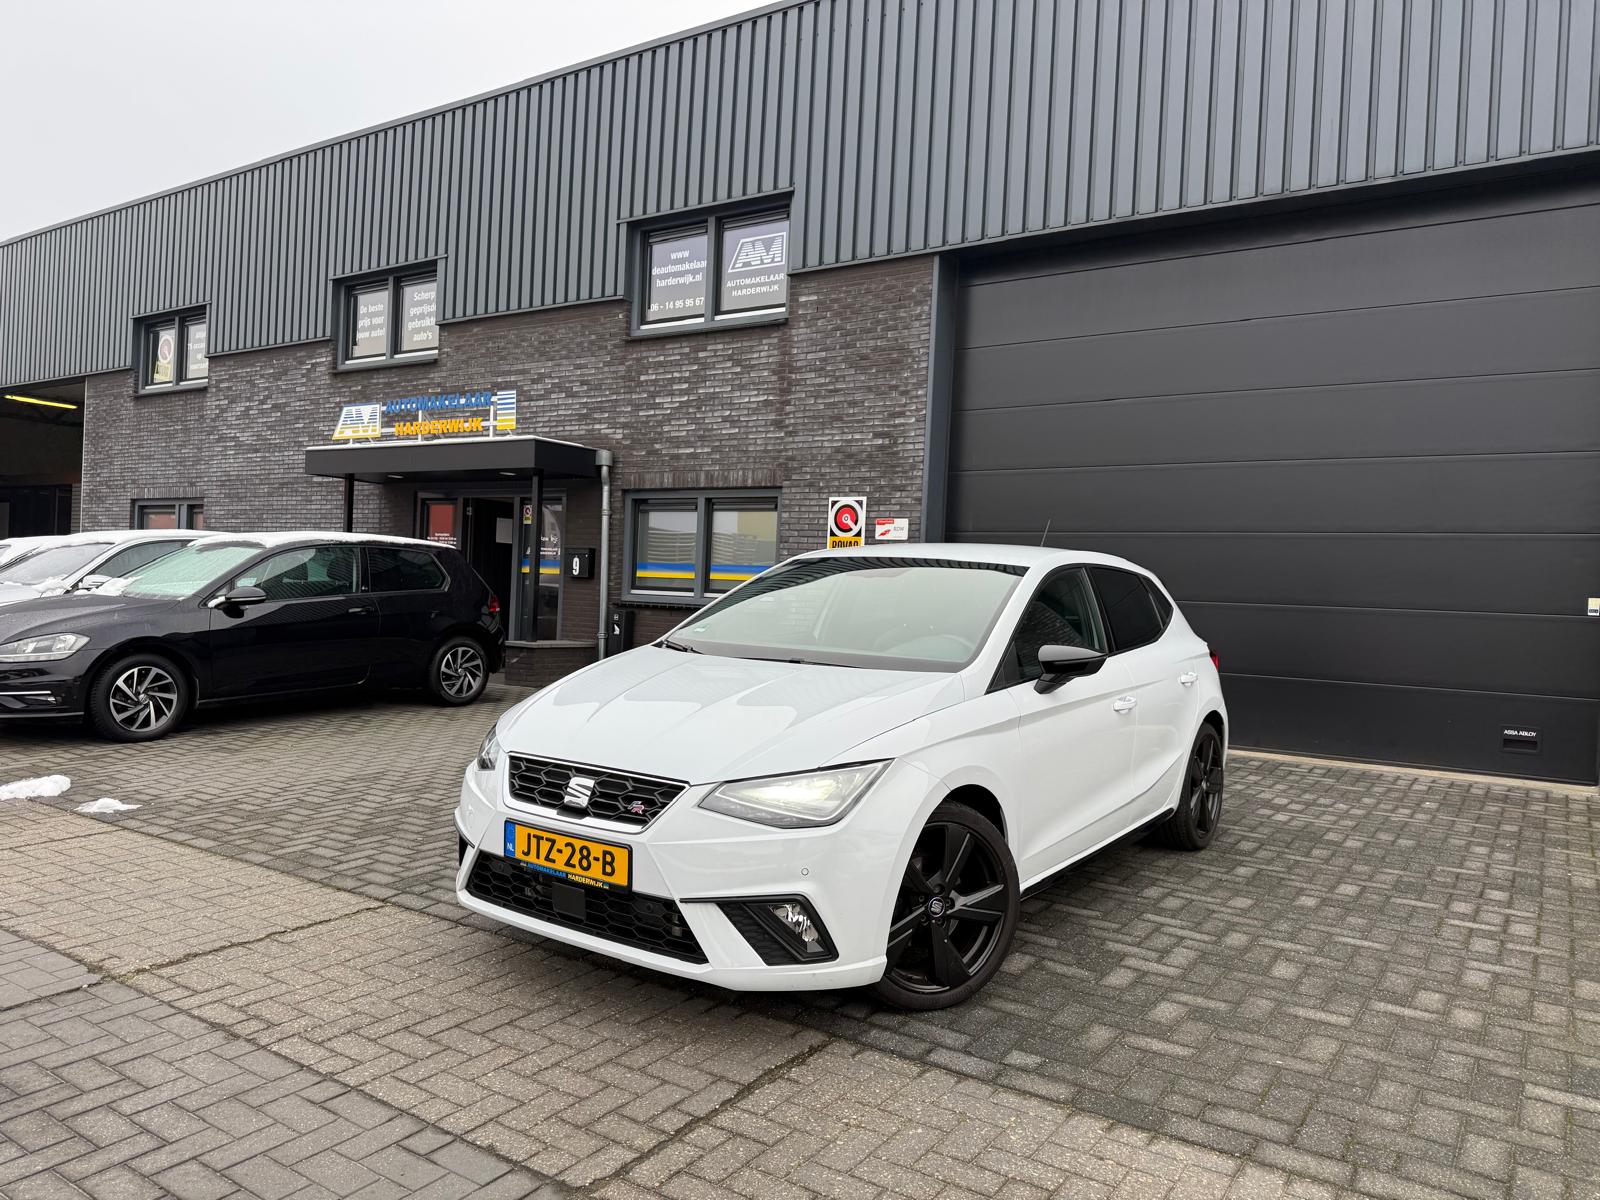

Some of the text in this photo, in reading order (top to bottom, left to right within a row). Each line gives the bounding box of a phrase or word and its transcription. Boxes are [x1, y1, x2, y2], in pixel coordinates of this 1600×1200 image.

[656, 271, 703, 288] harderwijk.nl
[727, 273, 785, 287] AUTOMAKELAAR
[731, 284, 780, 297] HARDERWIJK
[665, 300, 674, 311] 14
[674, 299, 684, 309] 95
[685, 298, 694, 308] 95
[385, 392, 493, 414] AUTOMAKELAAR
[395, 418, 484, 436] HARDERWIJK
[572, 556, 580, 576] 9
[521, 832, 616, 877] JTZ-28-B
[567, 873, 603, 888] HARDERWIJK
